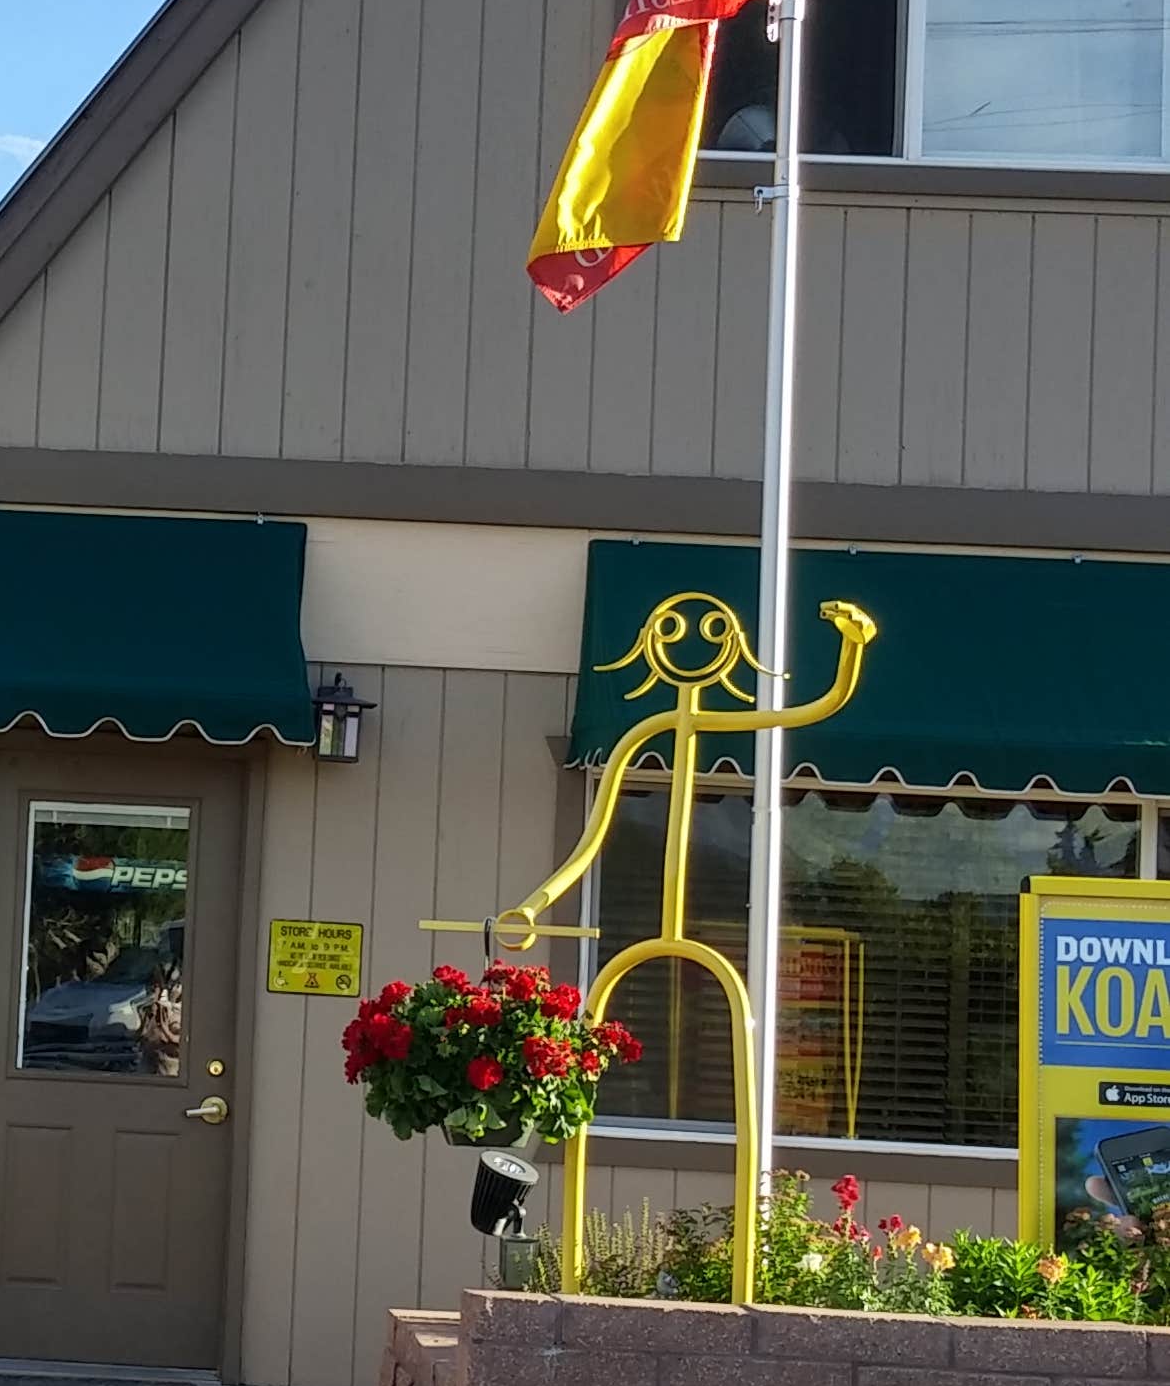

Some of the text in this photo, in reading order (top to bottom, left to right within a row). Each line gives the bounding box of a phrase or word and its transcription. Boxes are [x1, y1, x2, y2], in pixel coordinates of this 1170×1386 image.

[280, 925, 352, 940] STORE HOURS
[1056, 935, 1170, 966] DOWNL
[1056, 964, 1170, 1039] KOA
[1123, 1092, 1146, 1105] App
